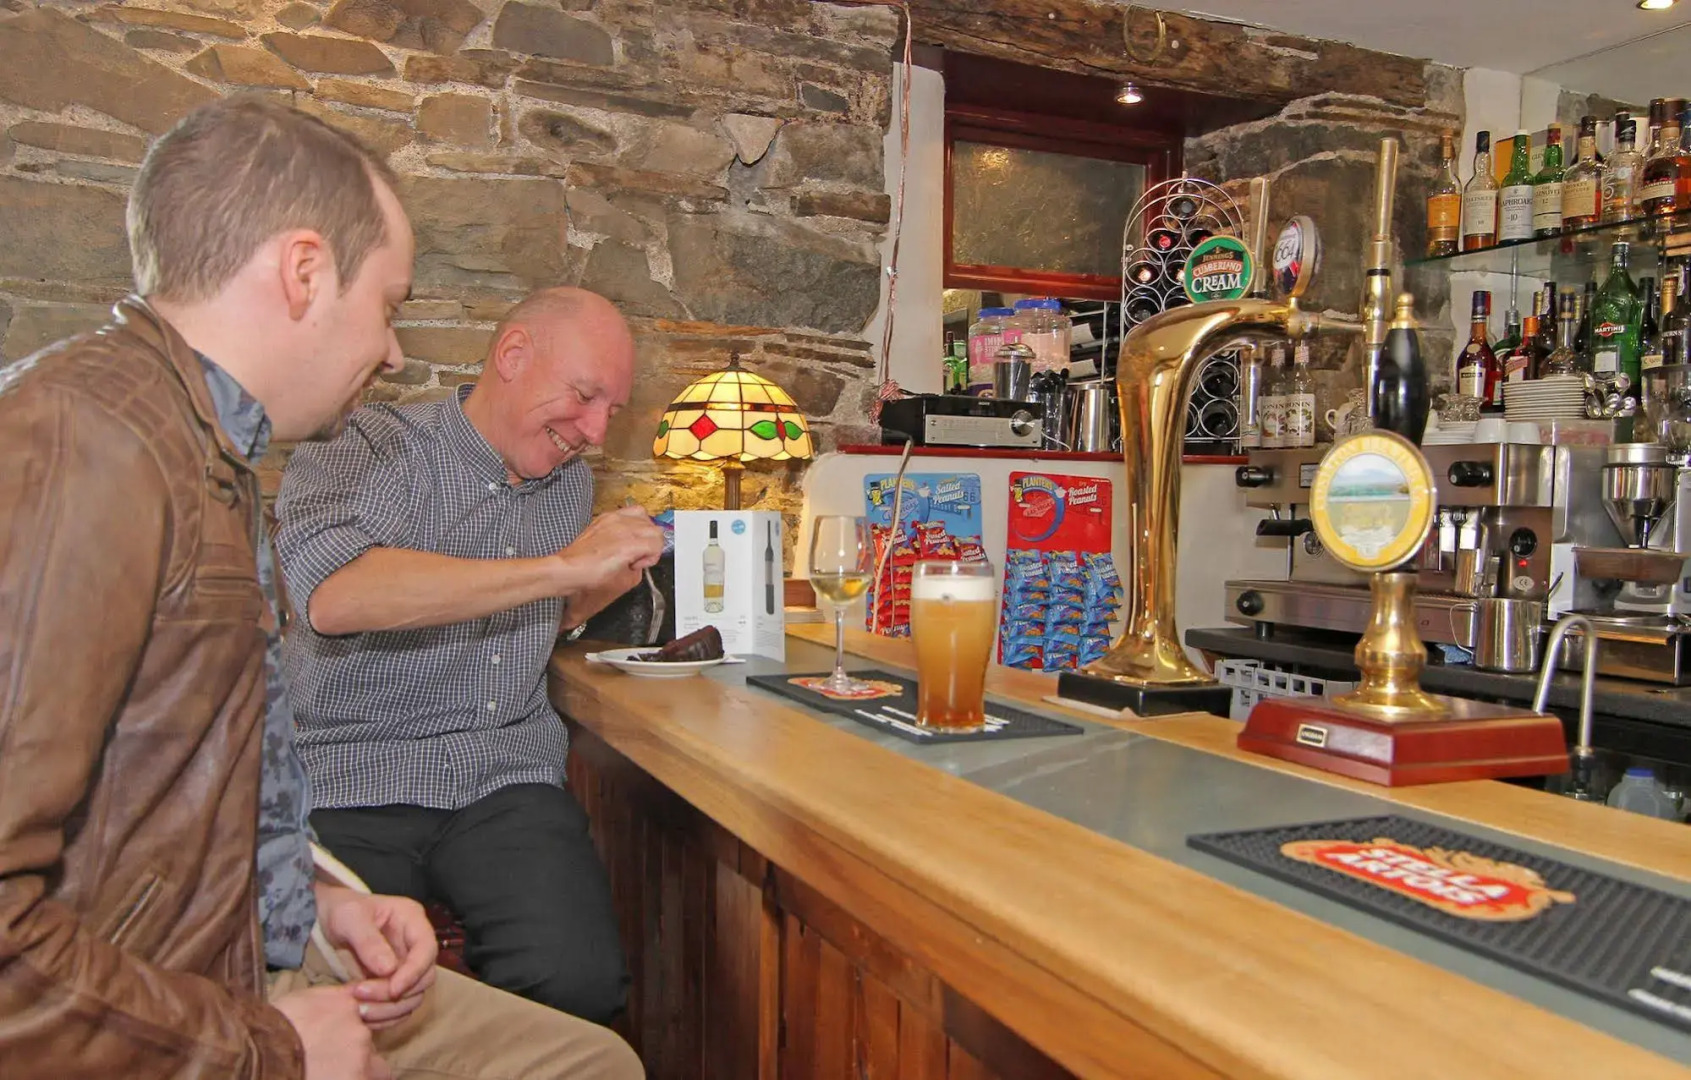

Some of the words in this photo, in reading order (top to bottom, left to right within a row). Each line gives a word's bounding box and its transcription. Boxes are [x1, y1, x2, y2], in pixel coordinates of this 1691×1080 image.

[1192, 262, 1243, 277] CUMBERLAND
[1191, 273, 1243, 293] CREAM
[936, 481, 961, 494] Salted
[1022, 476, 1053, 489] PLANTERS
[932, 491, 964, 505] Peanuts
[1068, 485, 1098, 497] Roasted
[1068, 494, 1098, 505] Peanuts
[1325, 852, 1488, 905] ARTOIS
[1358, 848, 1511, 899] STELLA
